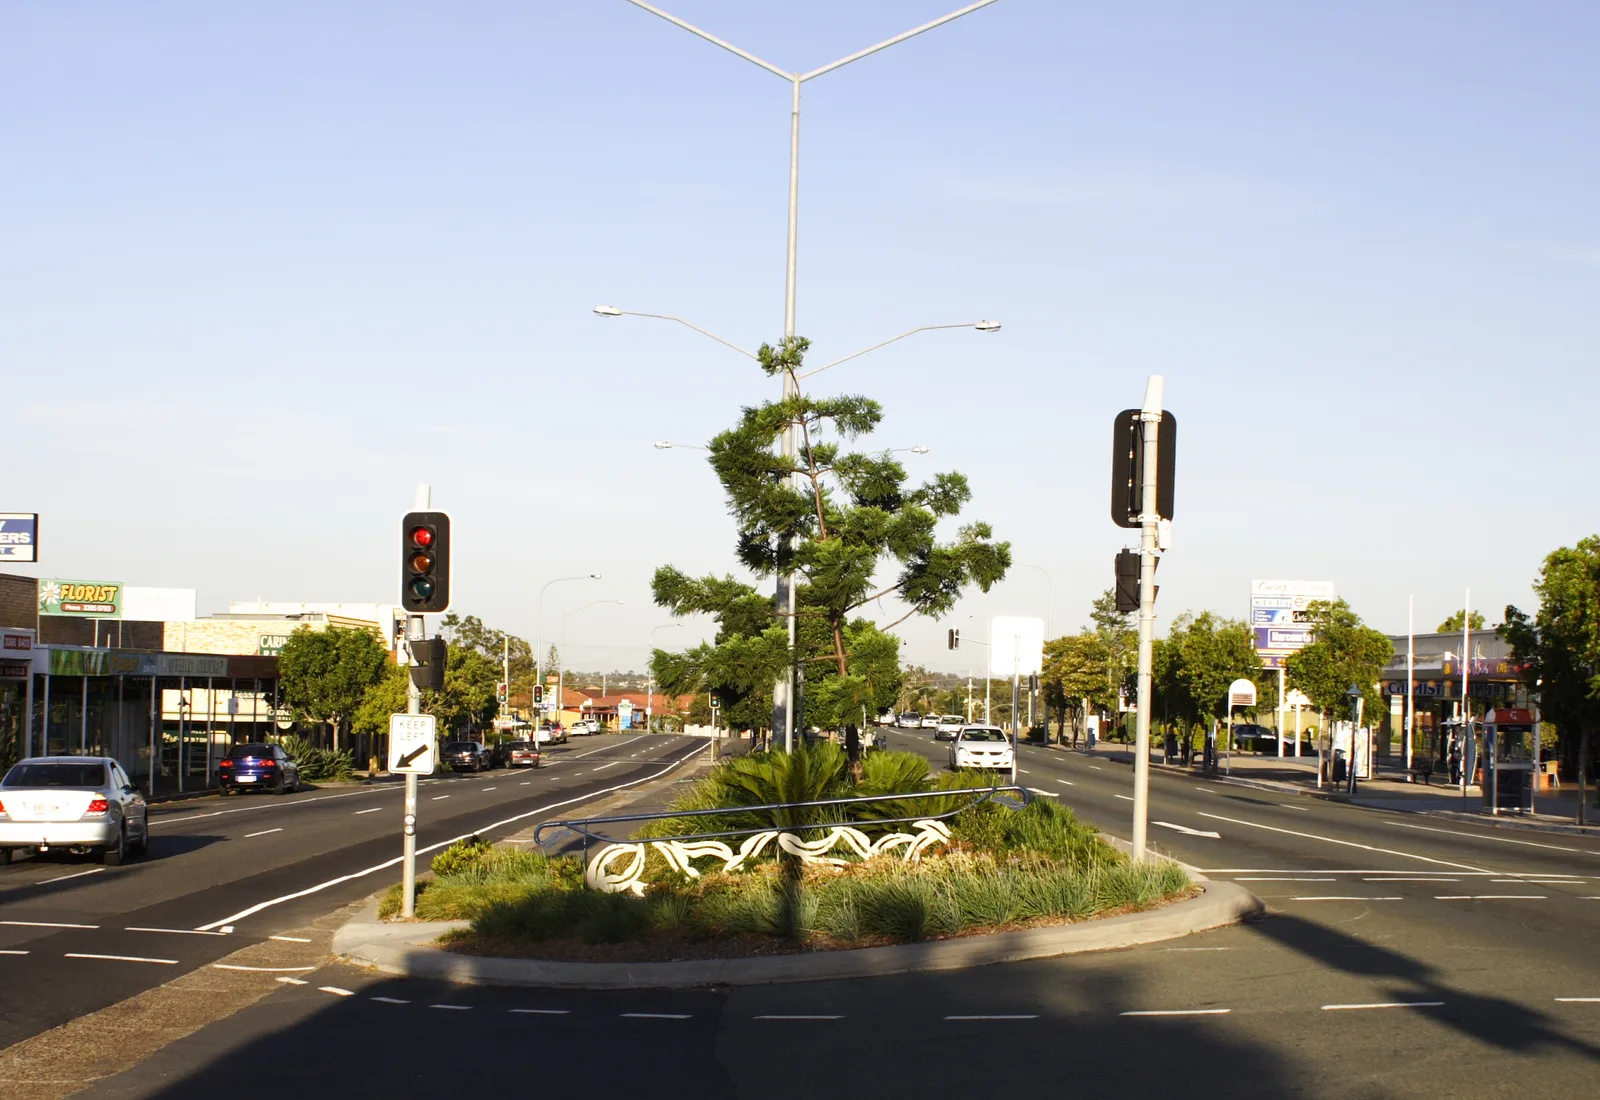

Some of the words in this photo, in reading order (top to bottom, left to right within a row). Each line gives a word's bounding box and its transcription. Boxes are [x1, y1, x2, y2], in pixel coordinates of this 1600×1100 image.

[60, 584, 118, 602] FLORIST
[1271, 631, 1312, 643] Harcourts
[400, 720, 427, 729] KEEP
[400, 732, 425, 741] LEFT
